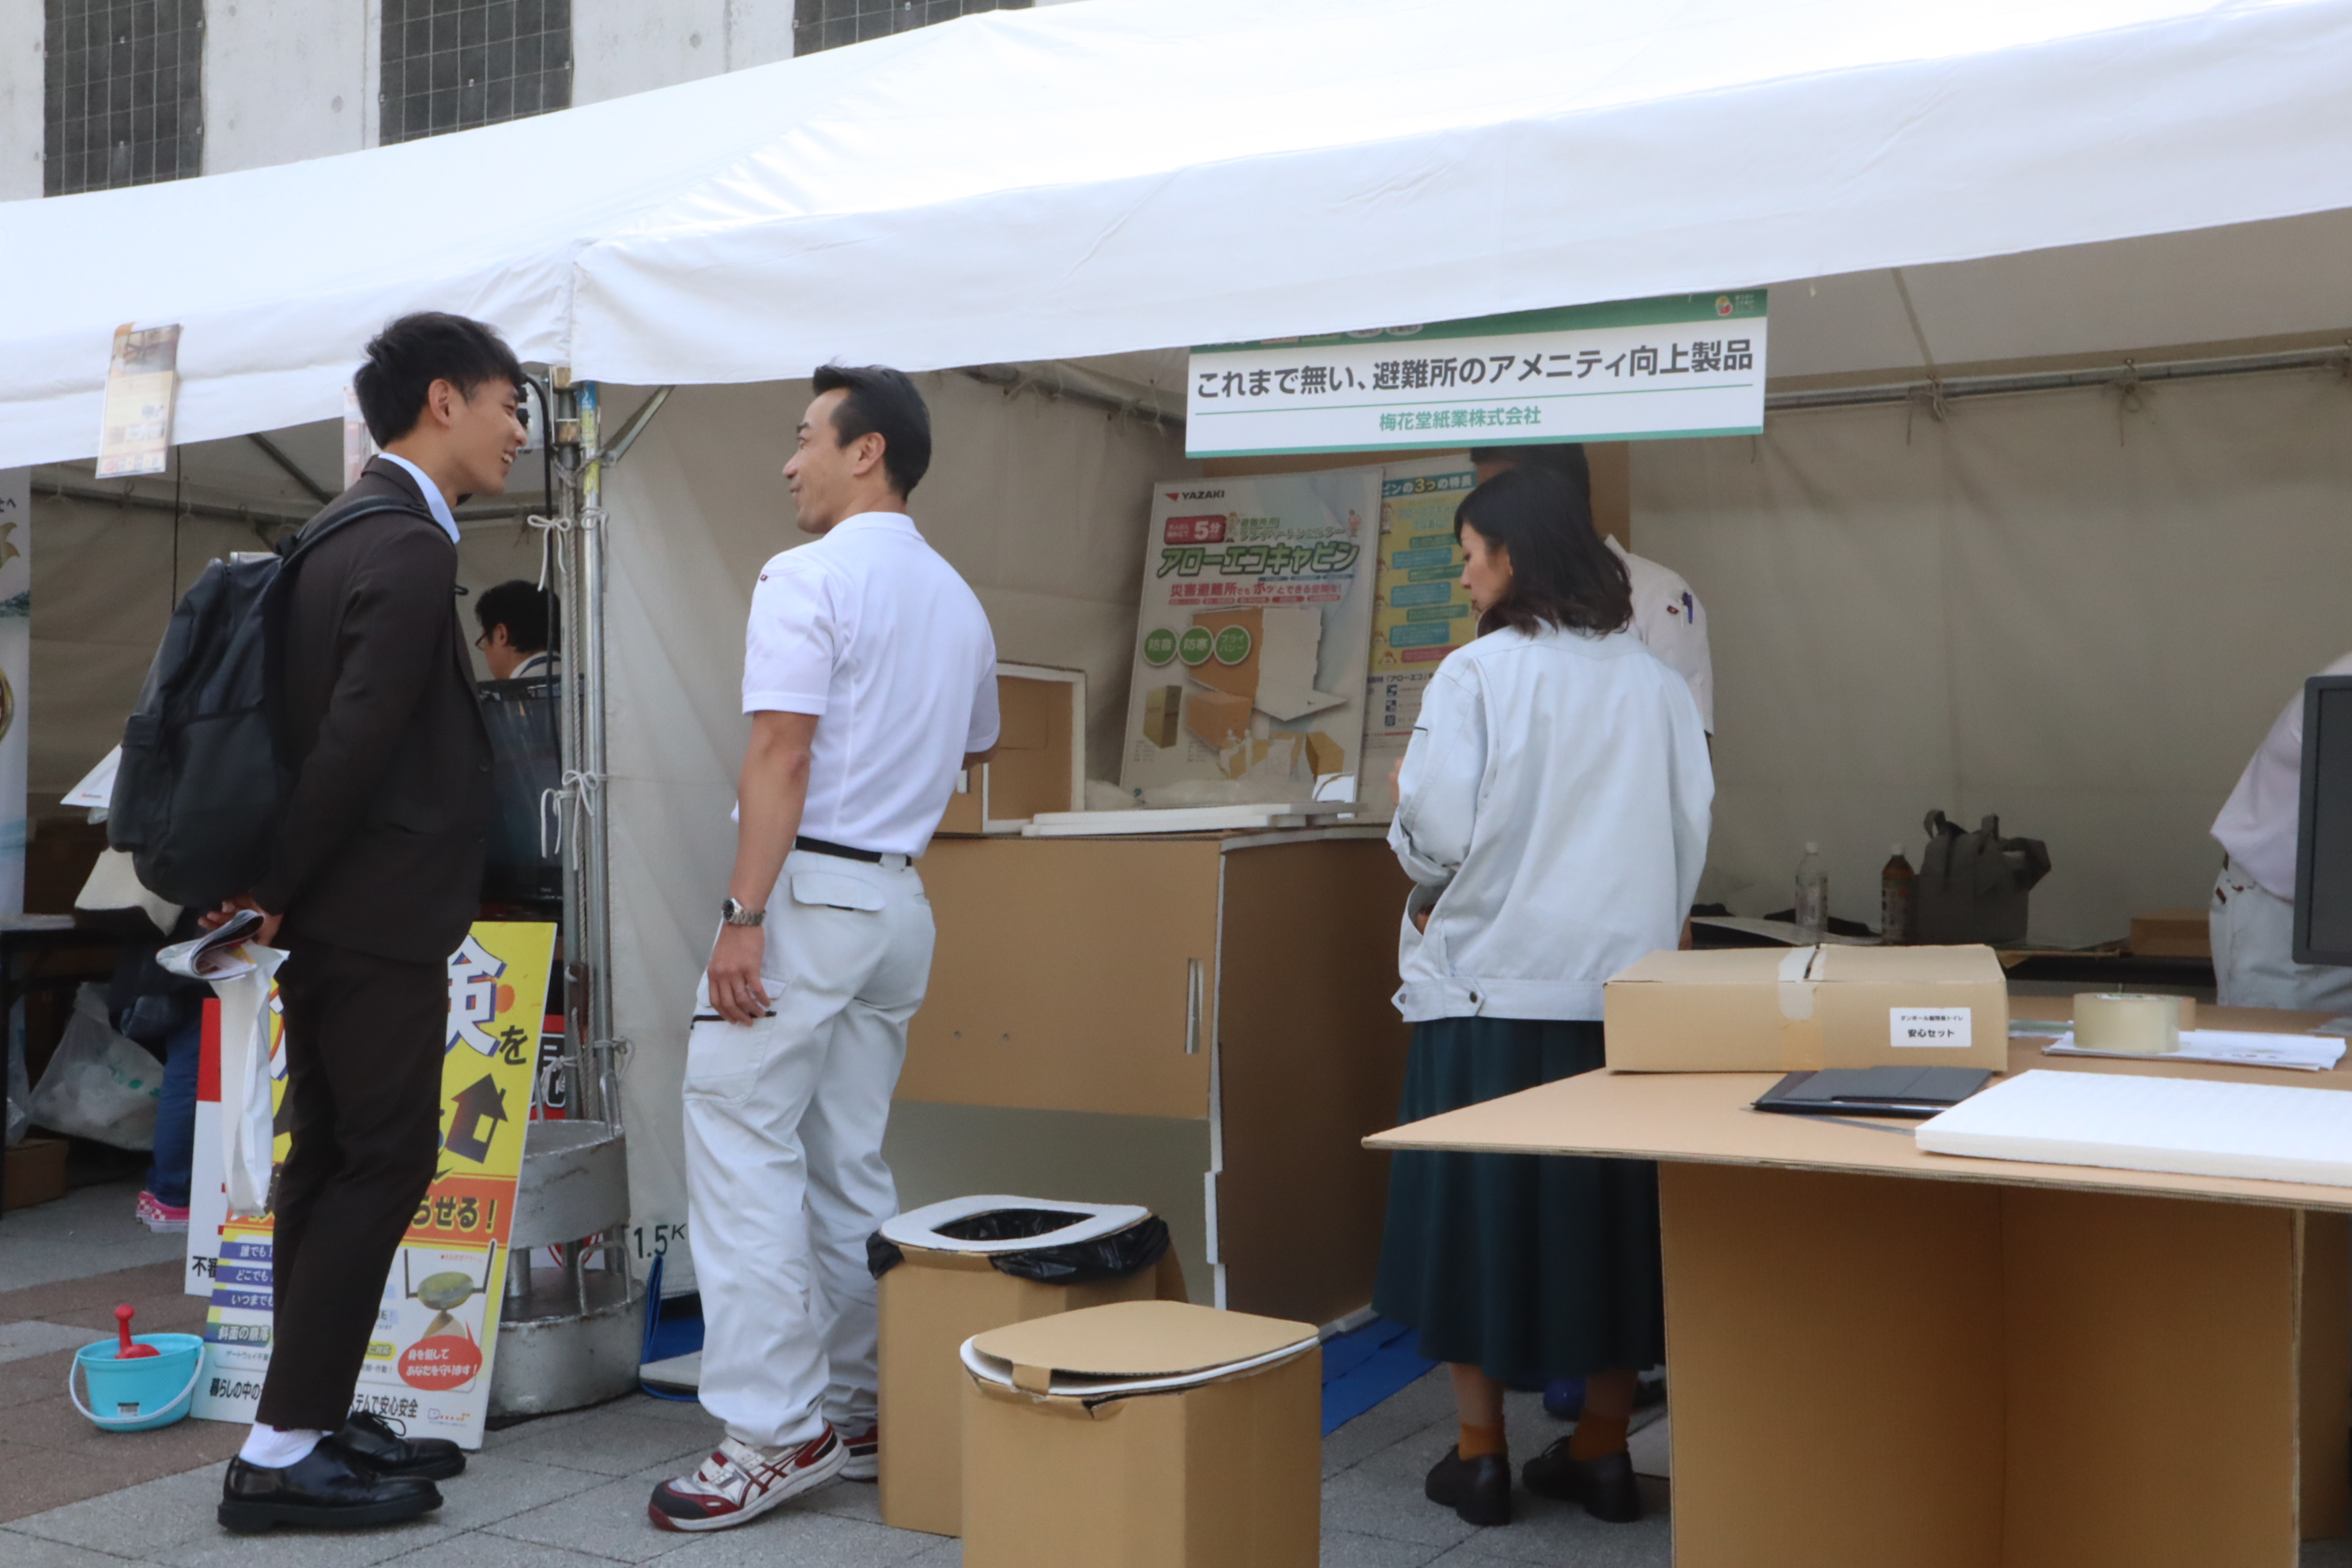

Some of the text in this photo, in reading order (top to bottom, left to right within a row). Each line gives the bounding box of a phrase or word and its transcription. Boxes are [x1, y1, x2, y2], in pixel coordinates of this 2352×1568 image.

[1197, 338, 1754, 399] これまで無い、避難所のアメニティ向上製品
[1379, 405, 1541, 432] 梅花堂紙業株式会社
[1182, 490, 1224, 500] YAZAKI
[1156, 541, 1361, 579] アローエコキャビン
[1148, 638, 1172, 651] 防音
[1908, 1029, 1954, 1038] 安心セット
[236, 1268, 273, 1283] どこでも
